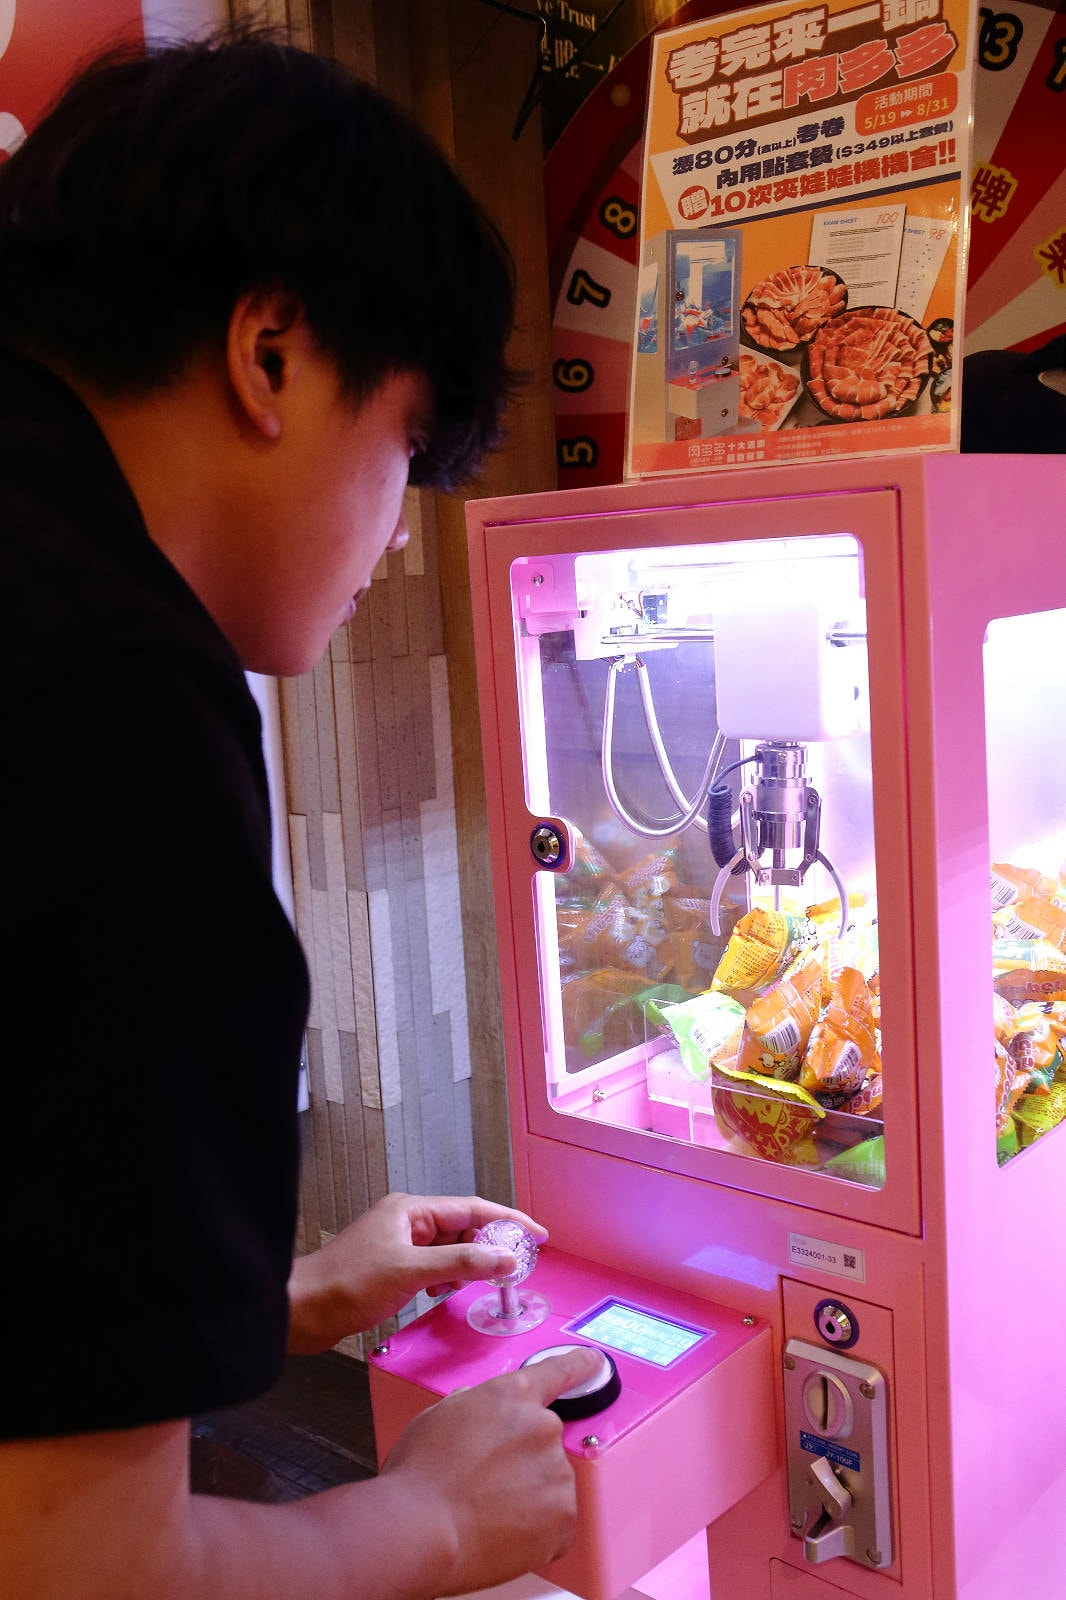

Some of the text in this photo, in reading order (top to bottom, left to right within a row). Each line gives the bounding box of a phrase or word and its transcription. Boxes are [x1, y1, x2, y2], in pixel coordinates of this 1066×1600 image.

[557, 0, 598, 32] Trust
[681, 22, 957, 135] 就在肉多多
[874, 82, 933, 111] 活動期間
[864, 97, 950, 130] 5/19 8/31
[602, 200, 637, 236] 8
[570, 272, 608, 304] 7
[560, 440, 595, 465] 5
